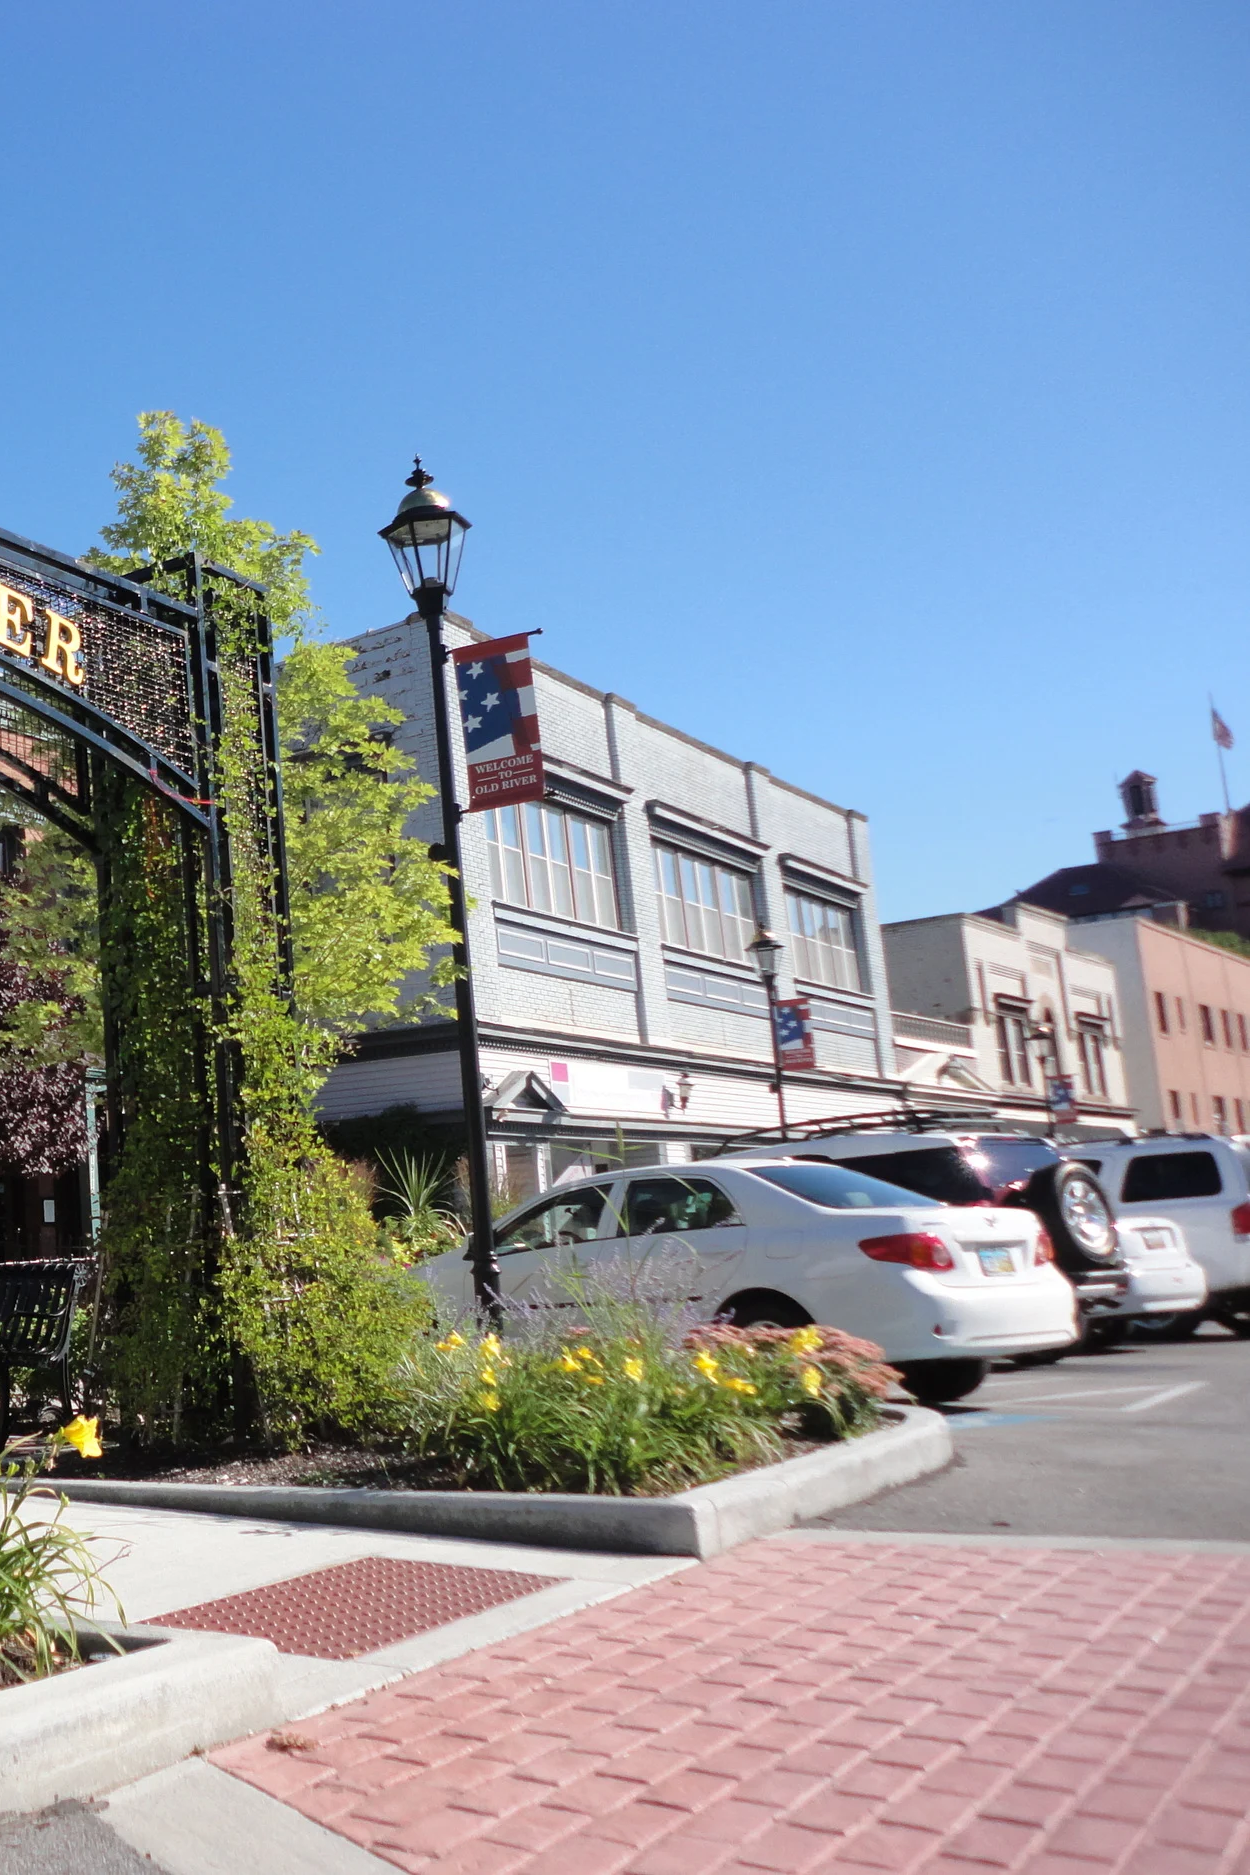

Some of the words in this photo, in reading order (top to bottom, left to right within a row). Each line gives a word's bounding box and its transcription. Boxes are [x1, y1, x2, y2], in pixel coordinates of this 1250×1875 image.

[475, 754, 534, 774] WELCOME
[475, 783, 499, 795] OLD
[502, 774, 537, 790] RIVER
[498, 770, 513, 780] TO
